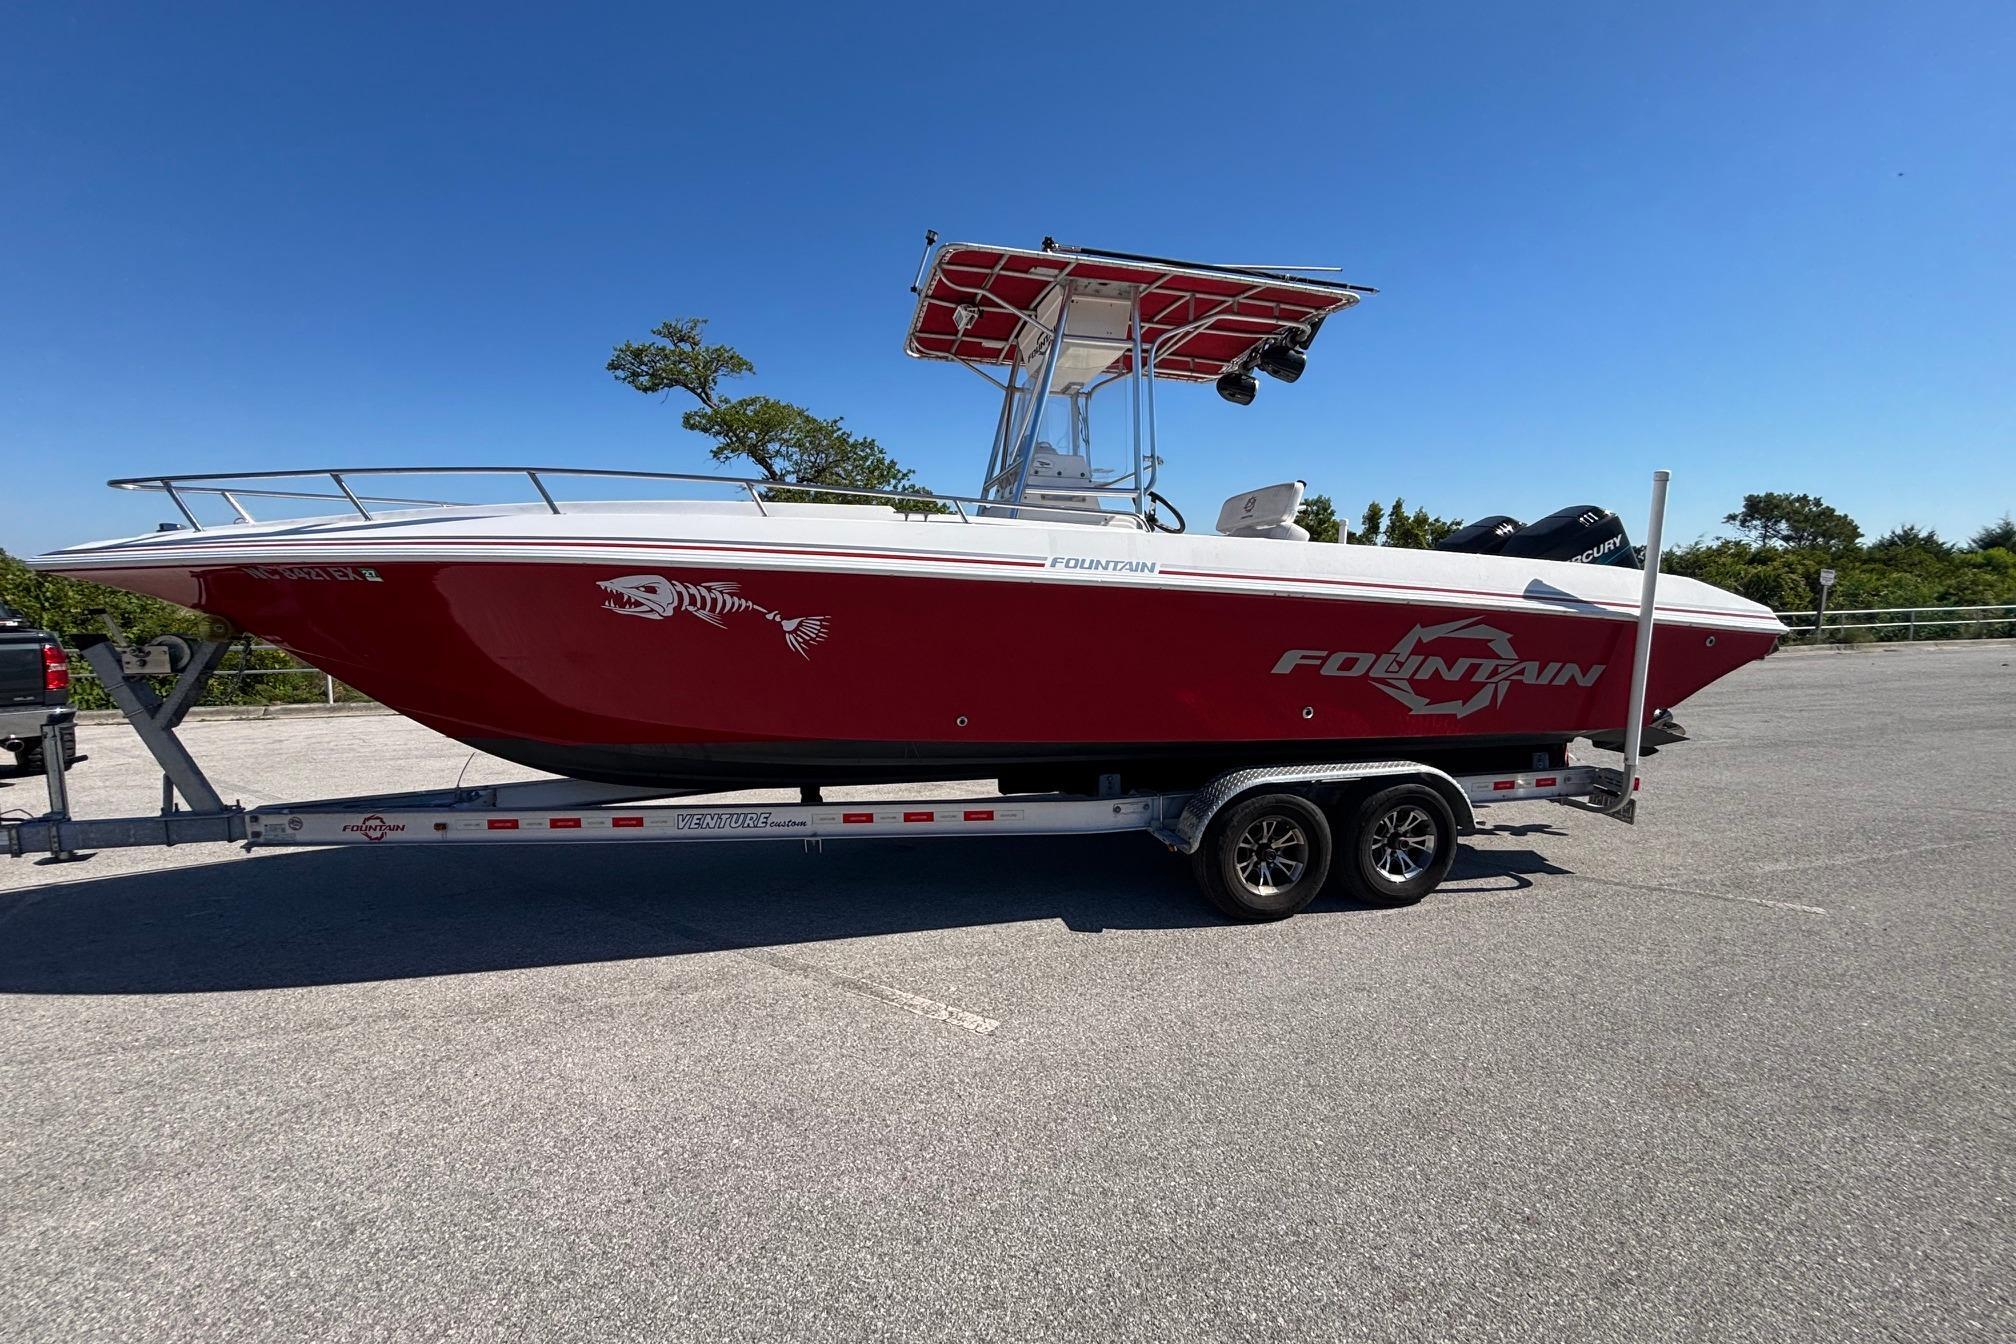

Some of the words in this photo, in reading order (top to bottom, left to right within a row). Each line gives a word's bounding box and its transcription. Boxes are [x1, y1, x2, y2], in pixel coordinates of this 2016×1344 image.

[1567, 533, 1622, 563] RCURY
[1049, 556, 1157, 574] FOUNTAIN
[1269, 649, 1607, 688] FOUNTAIN
[342, 823, 406, 832] FOUNTAIN
[676, 812, 772, 830] VENTURE
[769, 818, 808, 829] custom
